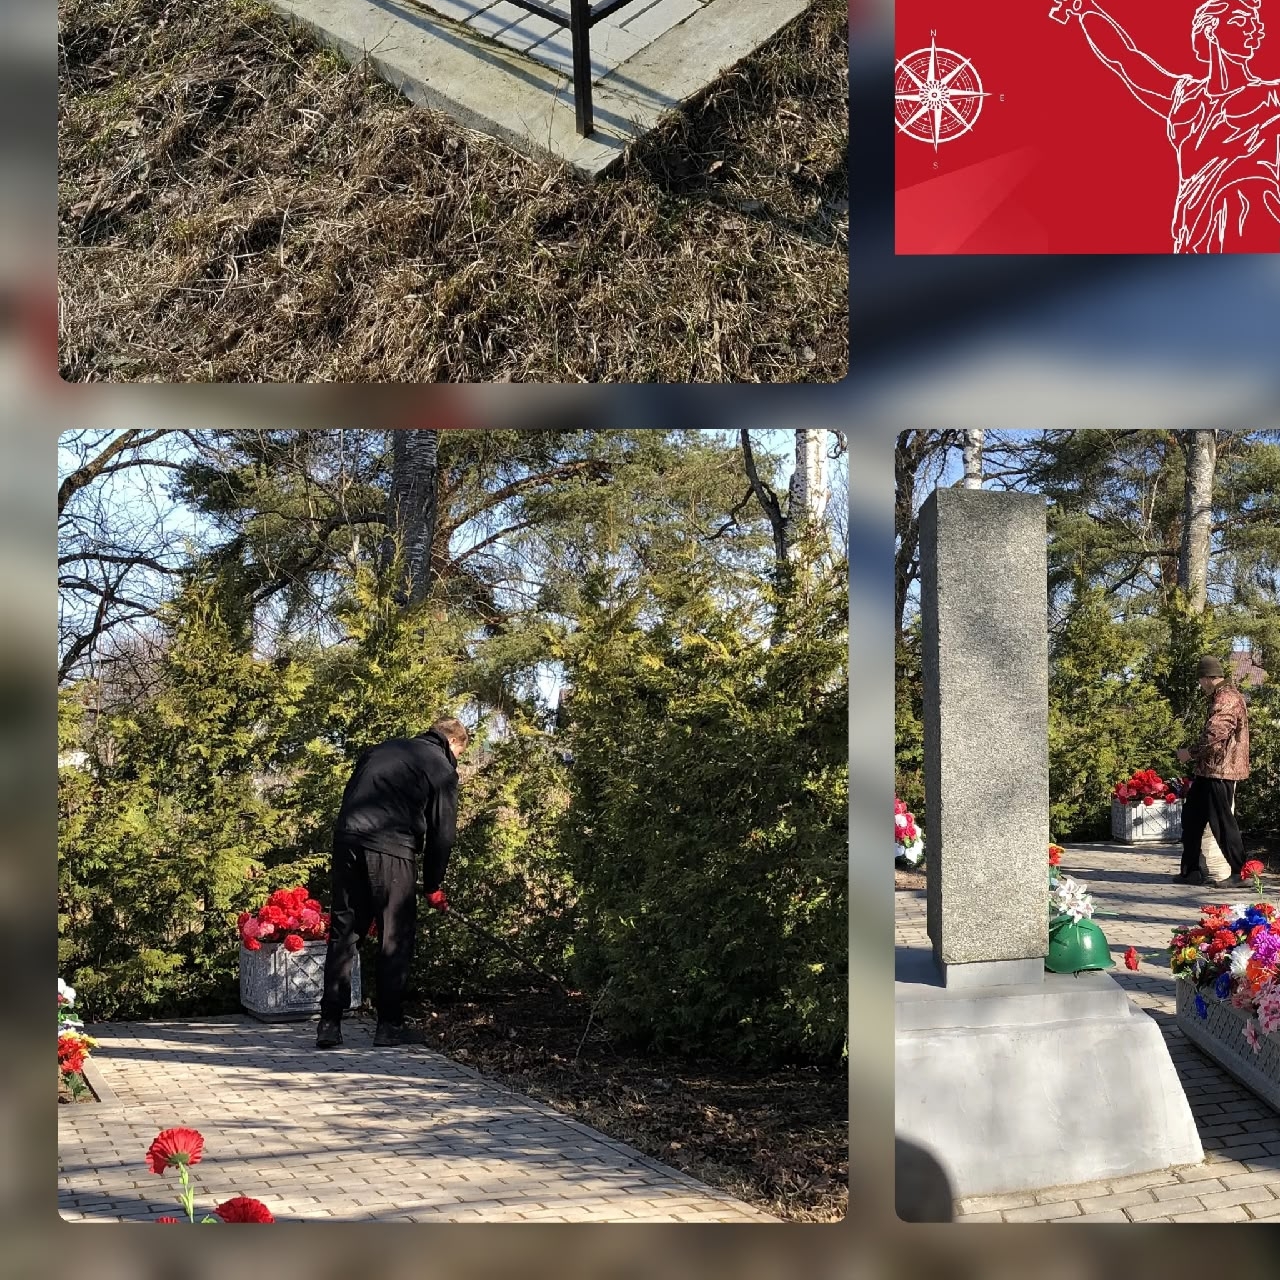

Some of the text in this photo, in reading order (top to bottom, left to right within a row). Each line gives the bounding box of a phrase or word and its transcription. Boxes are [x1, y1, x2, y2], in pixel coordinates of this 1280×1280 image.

[930, 29, 937, 37] N
[999, 93, 1005, 102] E
[932, 162, 939, 170] S
